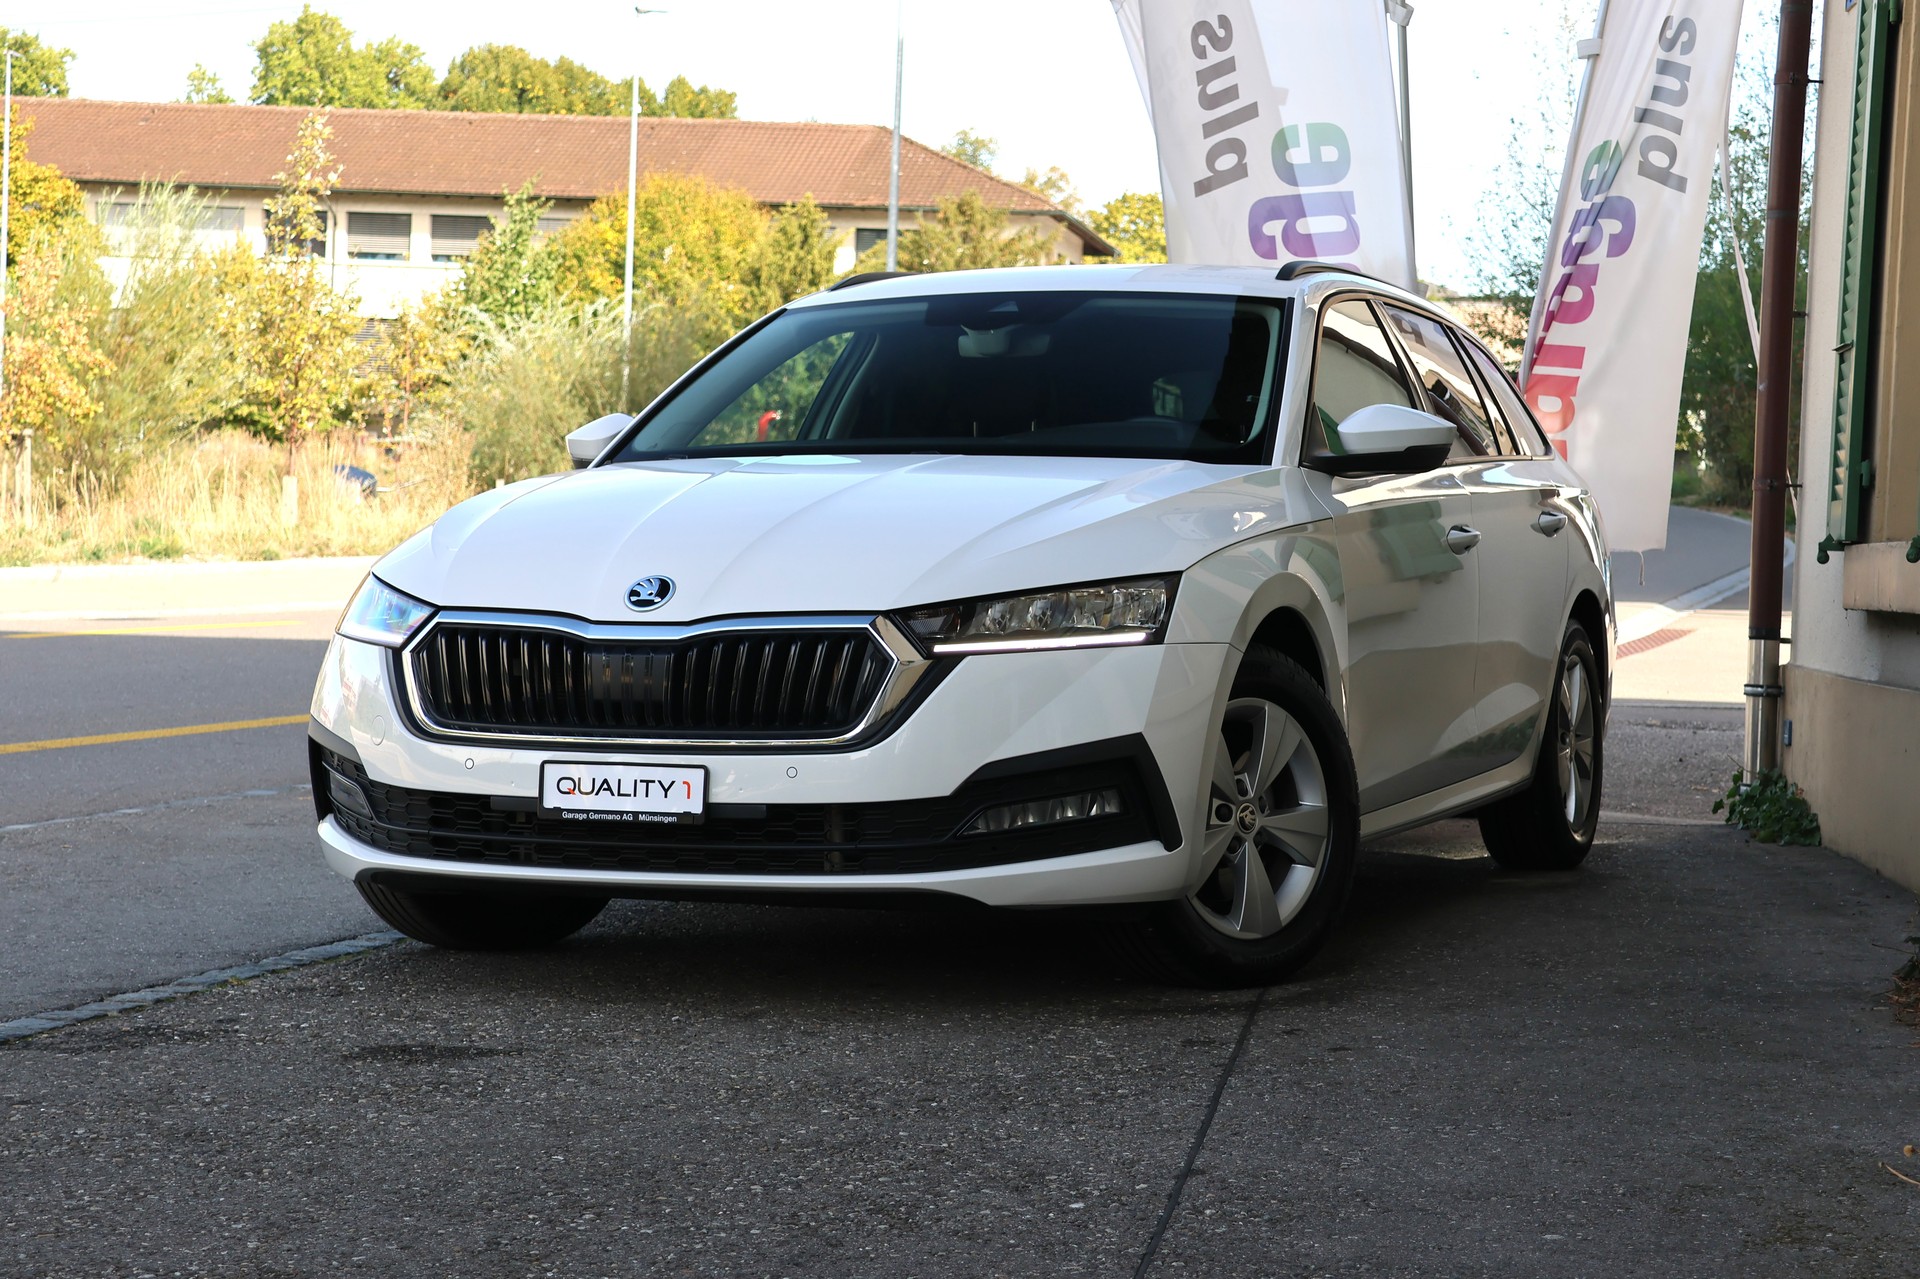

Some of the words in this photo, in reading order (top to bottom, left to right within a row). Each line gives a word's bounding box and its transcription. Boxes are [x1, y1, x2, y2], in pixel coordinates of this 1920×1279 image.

[1634, 15, 1697, 194] plus
[556, 776, 676, 799] QUALITY
[682, 780, 692, 799] 1
[562, 811, 587, 821] Garage
[589, 812, 621, 821] Germano
[622, 813, 633, 821] AG
[638, 813, 677, 823] Münsingen
